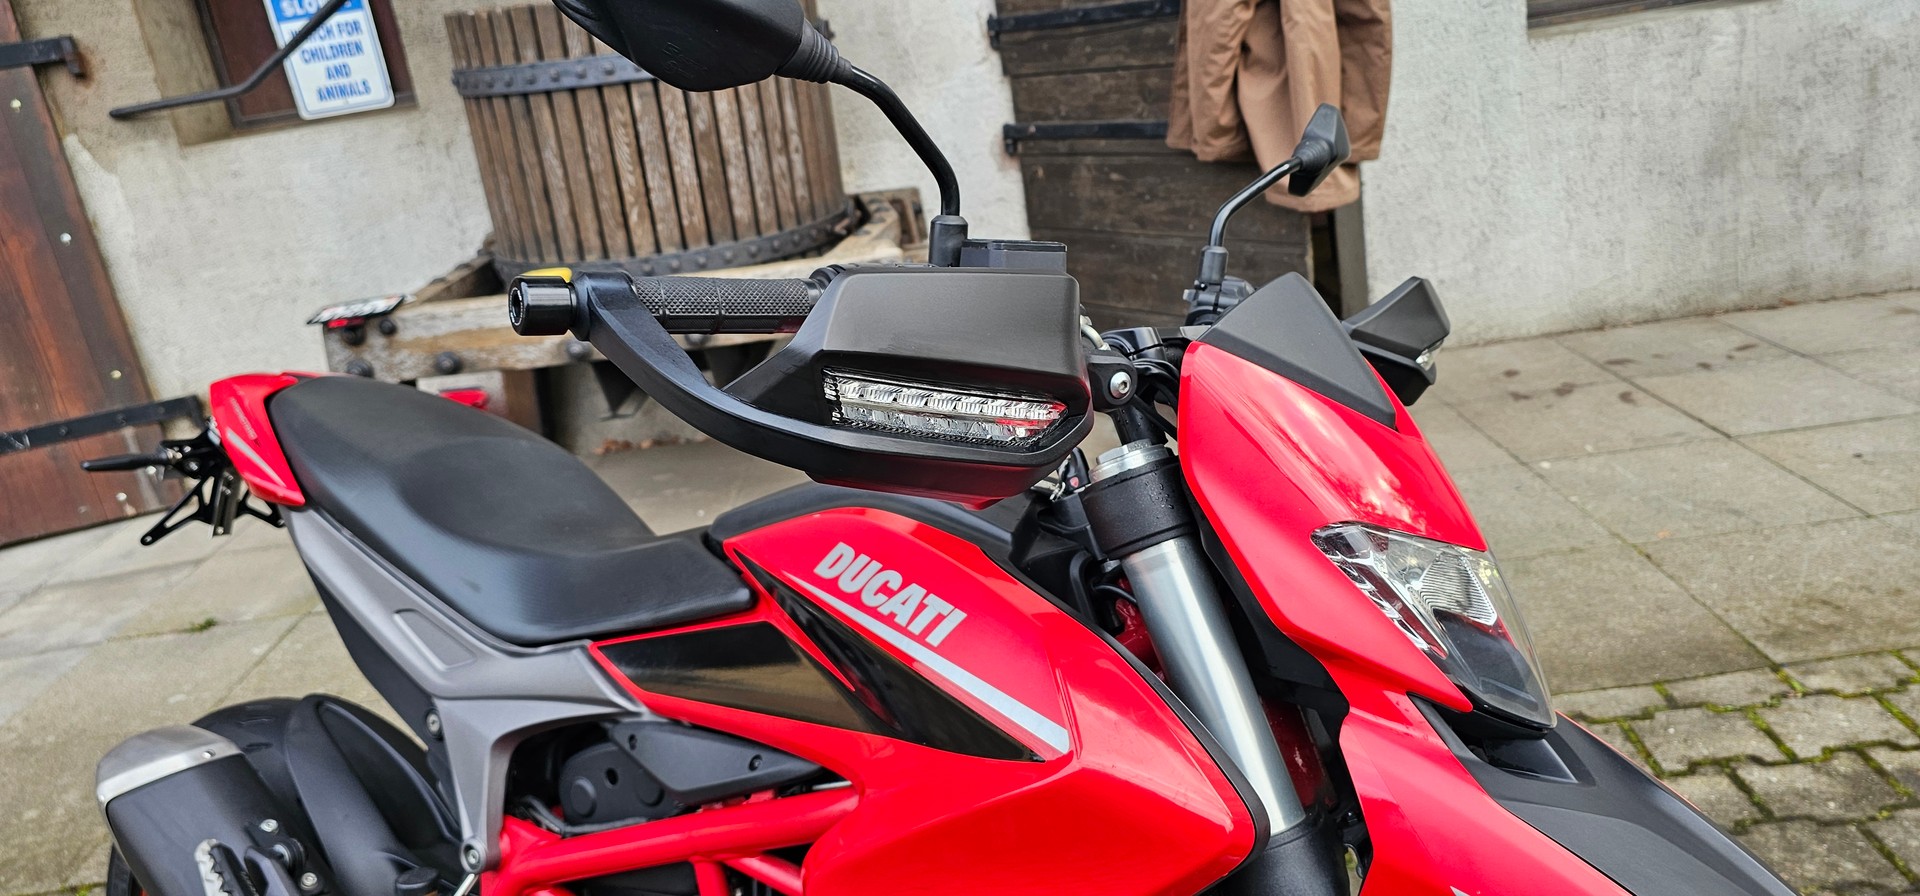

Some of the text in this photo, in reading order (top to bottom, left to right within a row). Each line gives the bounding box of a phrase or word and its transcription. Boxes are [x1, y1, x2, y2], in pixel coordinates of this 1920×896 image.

[338, 20, 362, 37] FOR
[302, 41, 364, 64] CHILDREN
[326, 63, 351, 80] AND
[317, 80, 371, 102] ANIMALS
[813, 541, 968, 648] DUCATI
